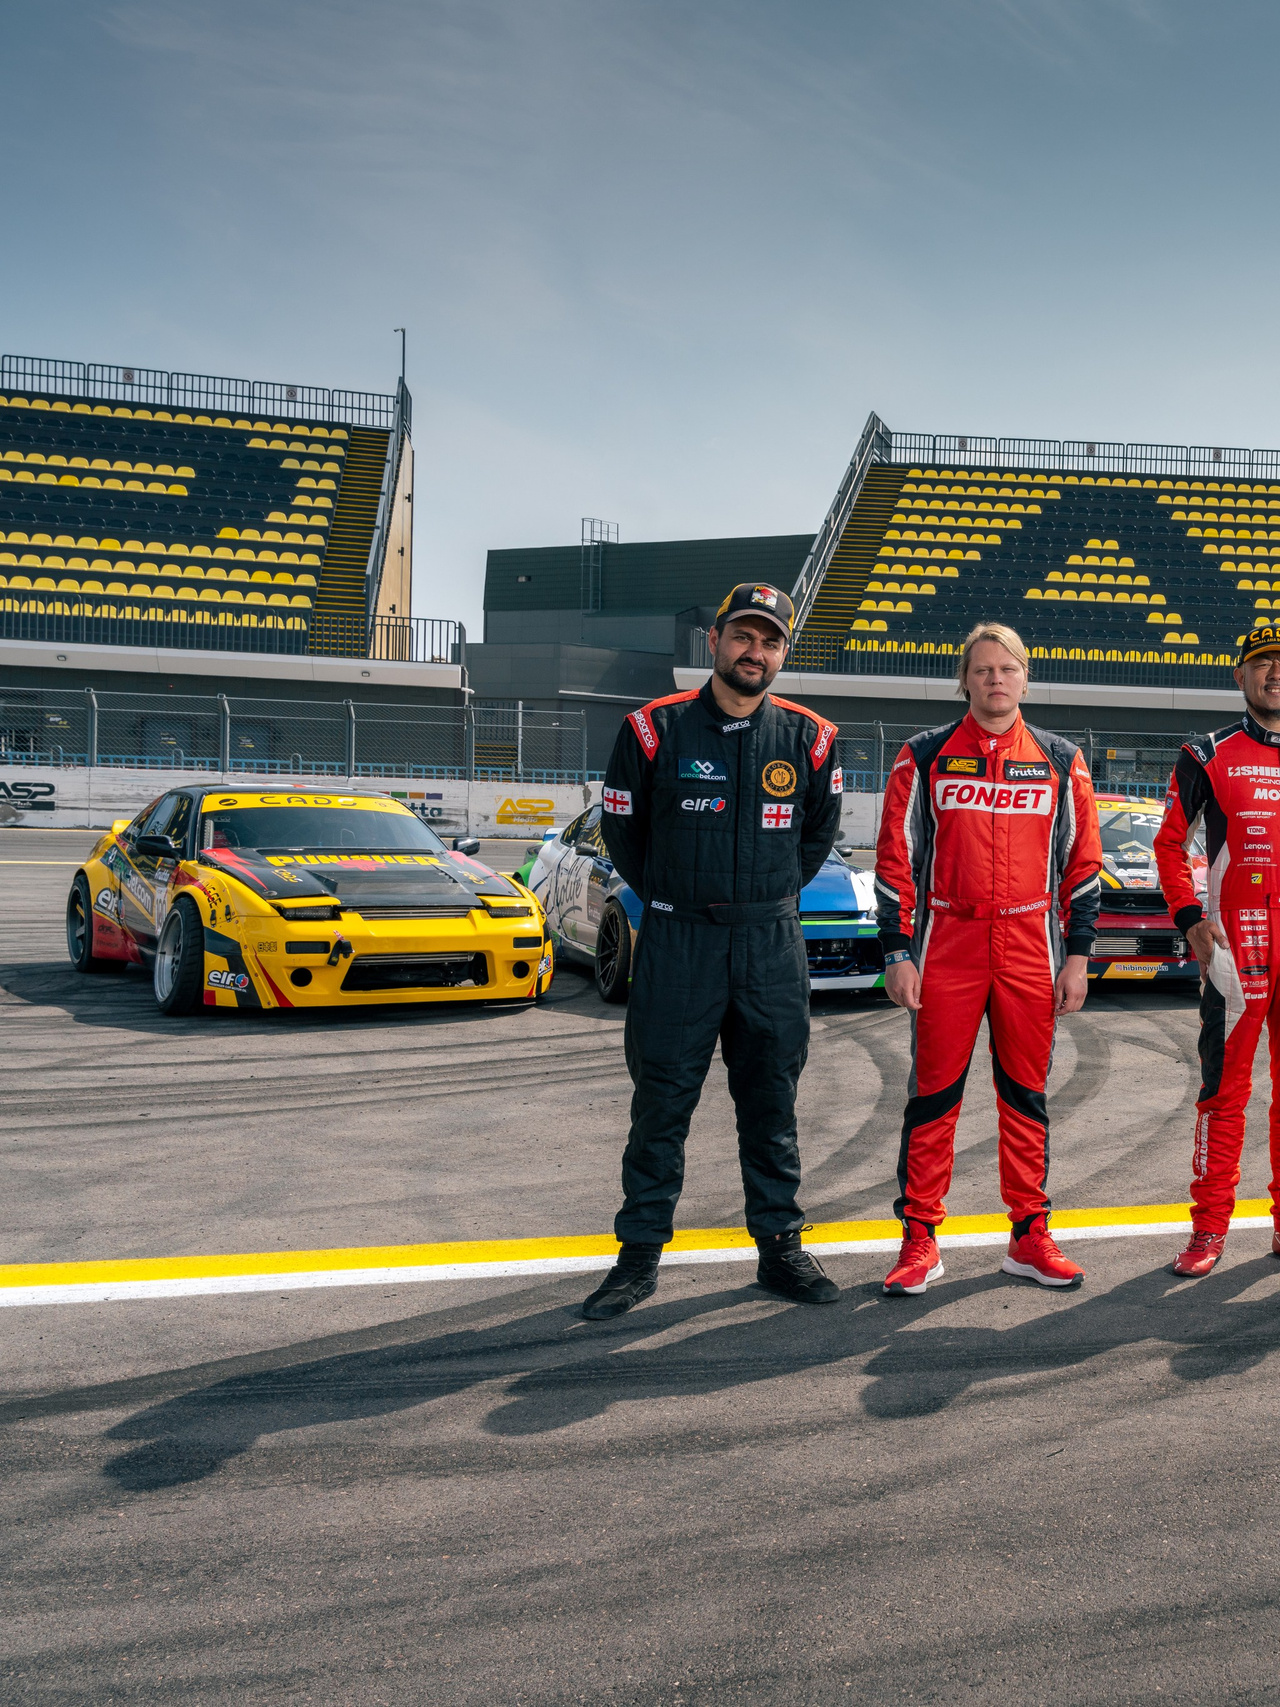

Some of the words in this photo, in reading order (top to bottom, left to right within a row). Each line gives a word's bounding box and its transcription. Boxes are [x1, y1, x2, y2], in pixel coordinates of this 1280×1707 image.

[721, 719, 751, 733] sparco
[814, 725, 834, 758] sparco
[989, 739, 997, 751] F
[948, 759, 978, 768] ASP
[680, 771, 727, 782] crocobet.com
[1008, 766, 1046, 777] frütta
[259, 795, 357, 807] CADS
[941, 783, 1047, 809] FONBET
[408, 803, 442, 818] tta
[498, 798, 555, 815] ASP
[681, 798, 711, 812] elf
[513, 816, 539, 824] Media
[265, 854, 451, 868] PUNISHER
[650, 900, 674, 912] sparco
[999, 908, 1008, 916] V.
[1008, 899, 1048, 915] SHUBADEROV
[1240, 910, 1267, 918] HKS
[1122, 963, 1169, 973] hibinojyuku
[208, 970, 236, 986] elf
